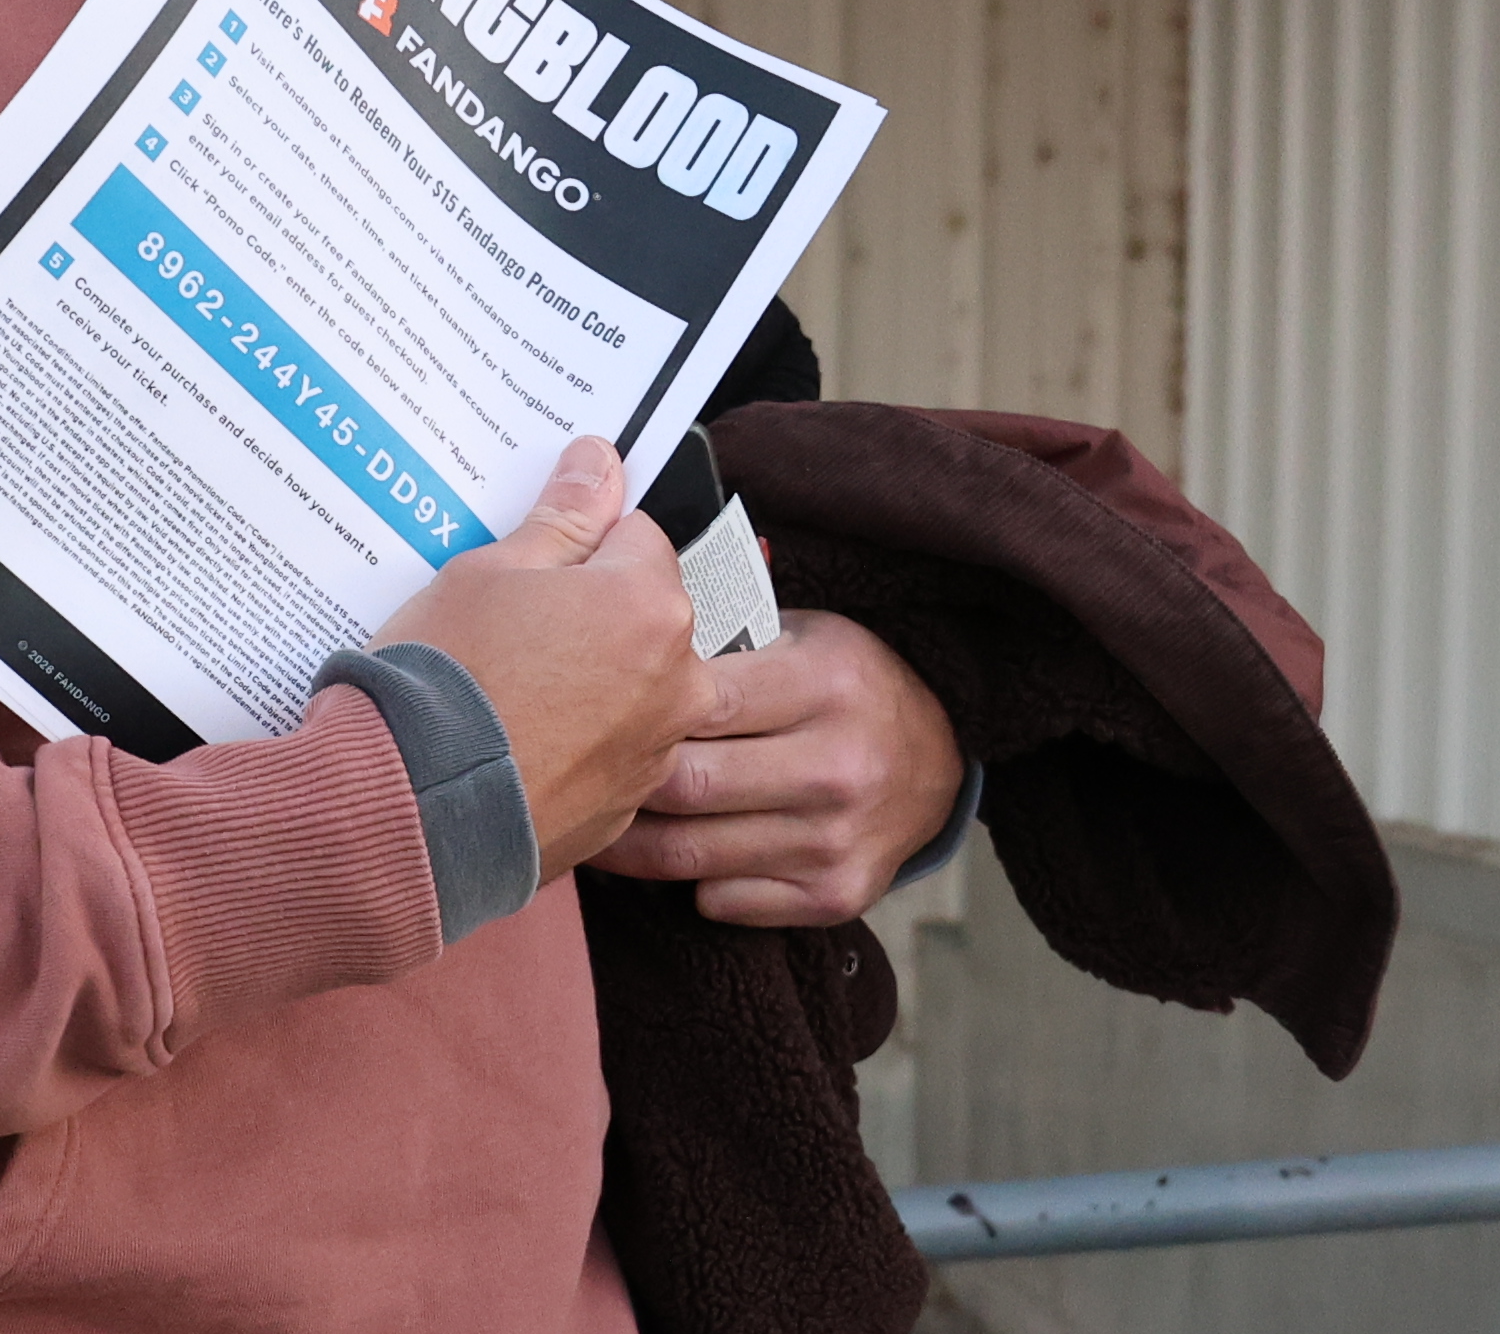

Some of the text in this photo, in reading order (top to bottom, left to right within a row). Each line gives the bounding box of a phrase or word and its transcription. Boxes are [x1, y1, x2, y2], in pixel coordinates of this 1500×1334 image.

[178, 89, 193, 105] 3
[202, 113, 228, 143] Sign
[229, 140, 241, 157] in
[243, 157, 257, 170] or
[258, 171, 292, 208] create
[293, 208, 320, 236] your
[321, 235, 343, 261] free
[344, 258, 396, 318] Fandango
[397, 316, 458, 388] FanRewards
[459, 388, 499, 434] account
[188, 134, 220, 166] enter
[219, 165, 248, 194] your
[249, 195, 282, 228] email
[281, 227, 325, 273] address
[326, 271, 344, 291] for
[343, 292, 375, 326] guest
[204, 51, 574, 434] 2 Select your date, theater, time, and ticket quantity for Youngblood.
[250, 42, 274, 74] Visit
[275, 71, 327, 132] Fandango
[329, 133, 341, 147] at
[341, 144, 415, 231] Fandango.com
[416, 232, 428, 244] or
[430, 245, 444, 264] via
[446, 263, 463, 284] the
[464, 282, 518, 339] Fandango
[520, 338, 564, 374] mobile
[566, 372, 593, 395] app.
[303, 34, 334, 73] How
[333, 68, 349, 92] to
[349, 86, 401, 152] Redeem
[402, 144, 432, 185] Your
[432, 180, 458, 212] $15
[456, 205, 525, 280] Fandango
[525, 271, 580, 321] Promo
[581, 310, 625, 348] Code
[395, 24, 590, 211] FANDANGO
[48, 252, 378, 565] 5 Complete your purchase and decide how you want to
[56, 298, 167, 406] receive your ticket.
[136, 231, 460, 548] 8962-244Y45-DD9X
[145, 137, 159, 151] 4
[169, 159, 199, 192] Click
[285, 276, 316, 306] enter
[317, 305, 335, 327] the
[337, 328, 364, 357] code
[365, 354, 399, 391] below
[400, 392, 422, 415] and
[422, 415, 446, 443] click
[5, 297, 27, 321] Terms
[27, 320, 43, 335] and
[42, 333, 84, 374] Conditions:
[84, 371, 113, 399] Limited
[111, 397, 128, 415] time
[128, 414, 146, 433] offer.
[147, 431, 183, 467] Fandango
[183, 464, 227, 506] Promotional
[226, 505, 245, 524] Code
[275, 551, 283, 560] is
[282, 559, 303, 577] good
[302, 575, 313, 587] for
[313, 587, 324, 598] up
[324, 595, 332, 605] to
[333, 603, 348, 618] $15
[347, 617, 359, 628] off
[11, 323, 51, 360] associated
[50, 358, 67, 375] fees
[67, 375, 83, 389] and
[113, 417, 126, 431] the
[124, 430, 159, 462] purchase
[158, 460, 169, 469] of
[167, 468, 182, 483] one
[181, 482, 204, 503] movie
[204, 501, 225, 523] ticket
[224, 521, 233, 530] to
[233, 530, 246, 543] see
[247, 541, 289, 582] Youngblood
[288, 580, 297, 590] at
[295, 588, 342, 631] participating
[24, 474, 38, 488] will
[37, 487, 51, 500] not
[50, 498, 61, 510] be
[96, 539, 129, 571] Excludes
[129, 570, 160, 598] multiple
[160, 597, 198, 631] admission
[226, 653, 246, 673] Limit
[251, 675, 271, 695] Code
[269, 693, 284, 706] per
[34, 465, 51, 483] then
[51, 483, 68, 498] user
[67, 498, 87, 517] must
[85, 515, 101, 530] pay
[101, 528, 114, 542] the
[153, 575, 170, 591] Any
[168, 589, 189, 607] price
[189, 606, 227, 640] difference
[227, 638, 259, 668] between
[259, 667, 282, 688] movie
[282, 686, 304, 708] ticket
[27, 650, 55, 675] 2026
[53, 672, 111, 723] FANDANGO
